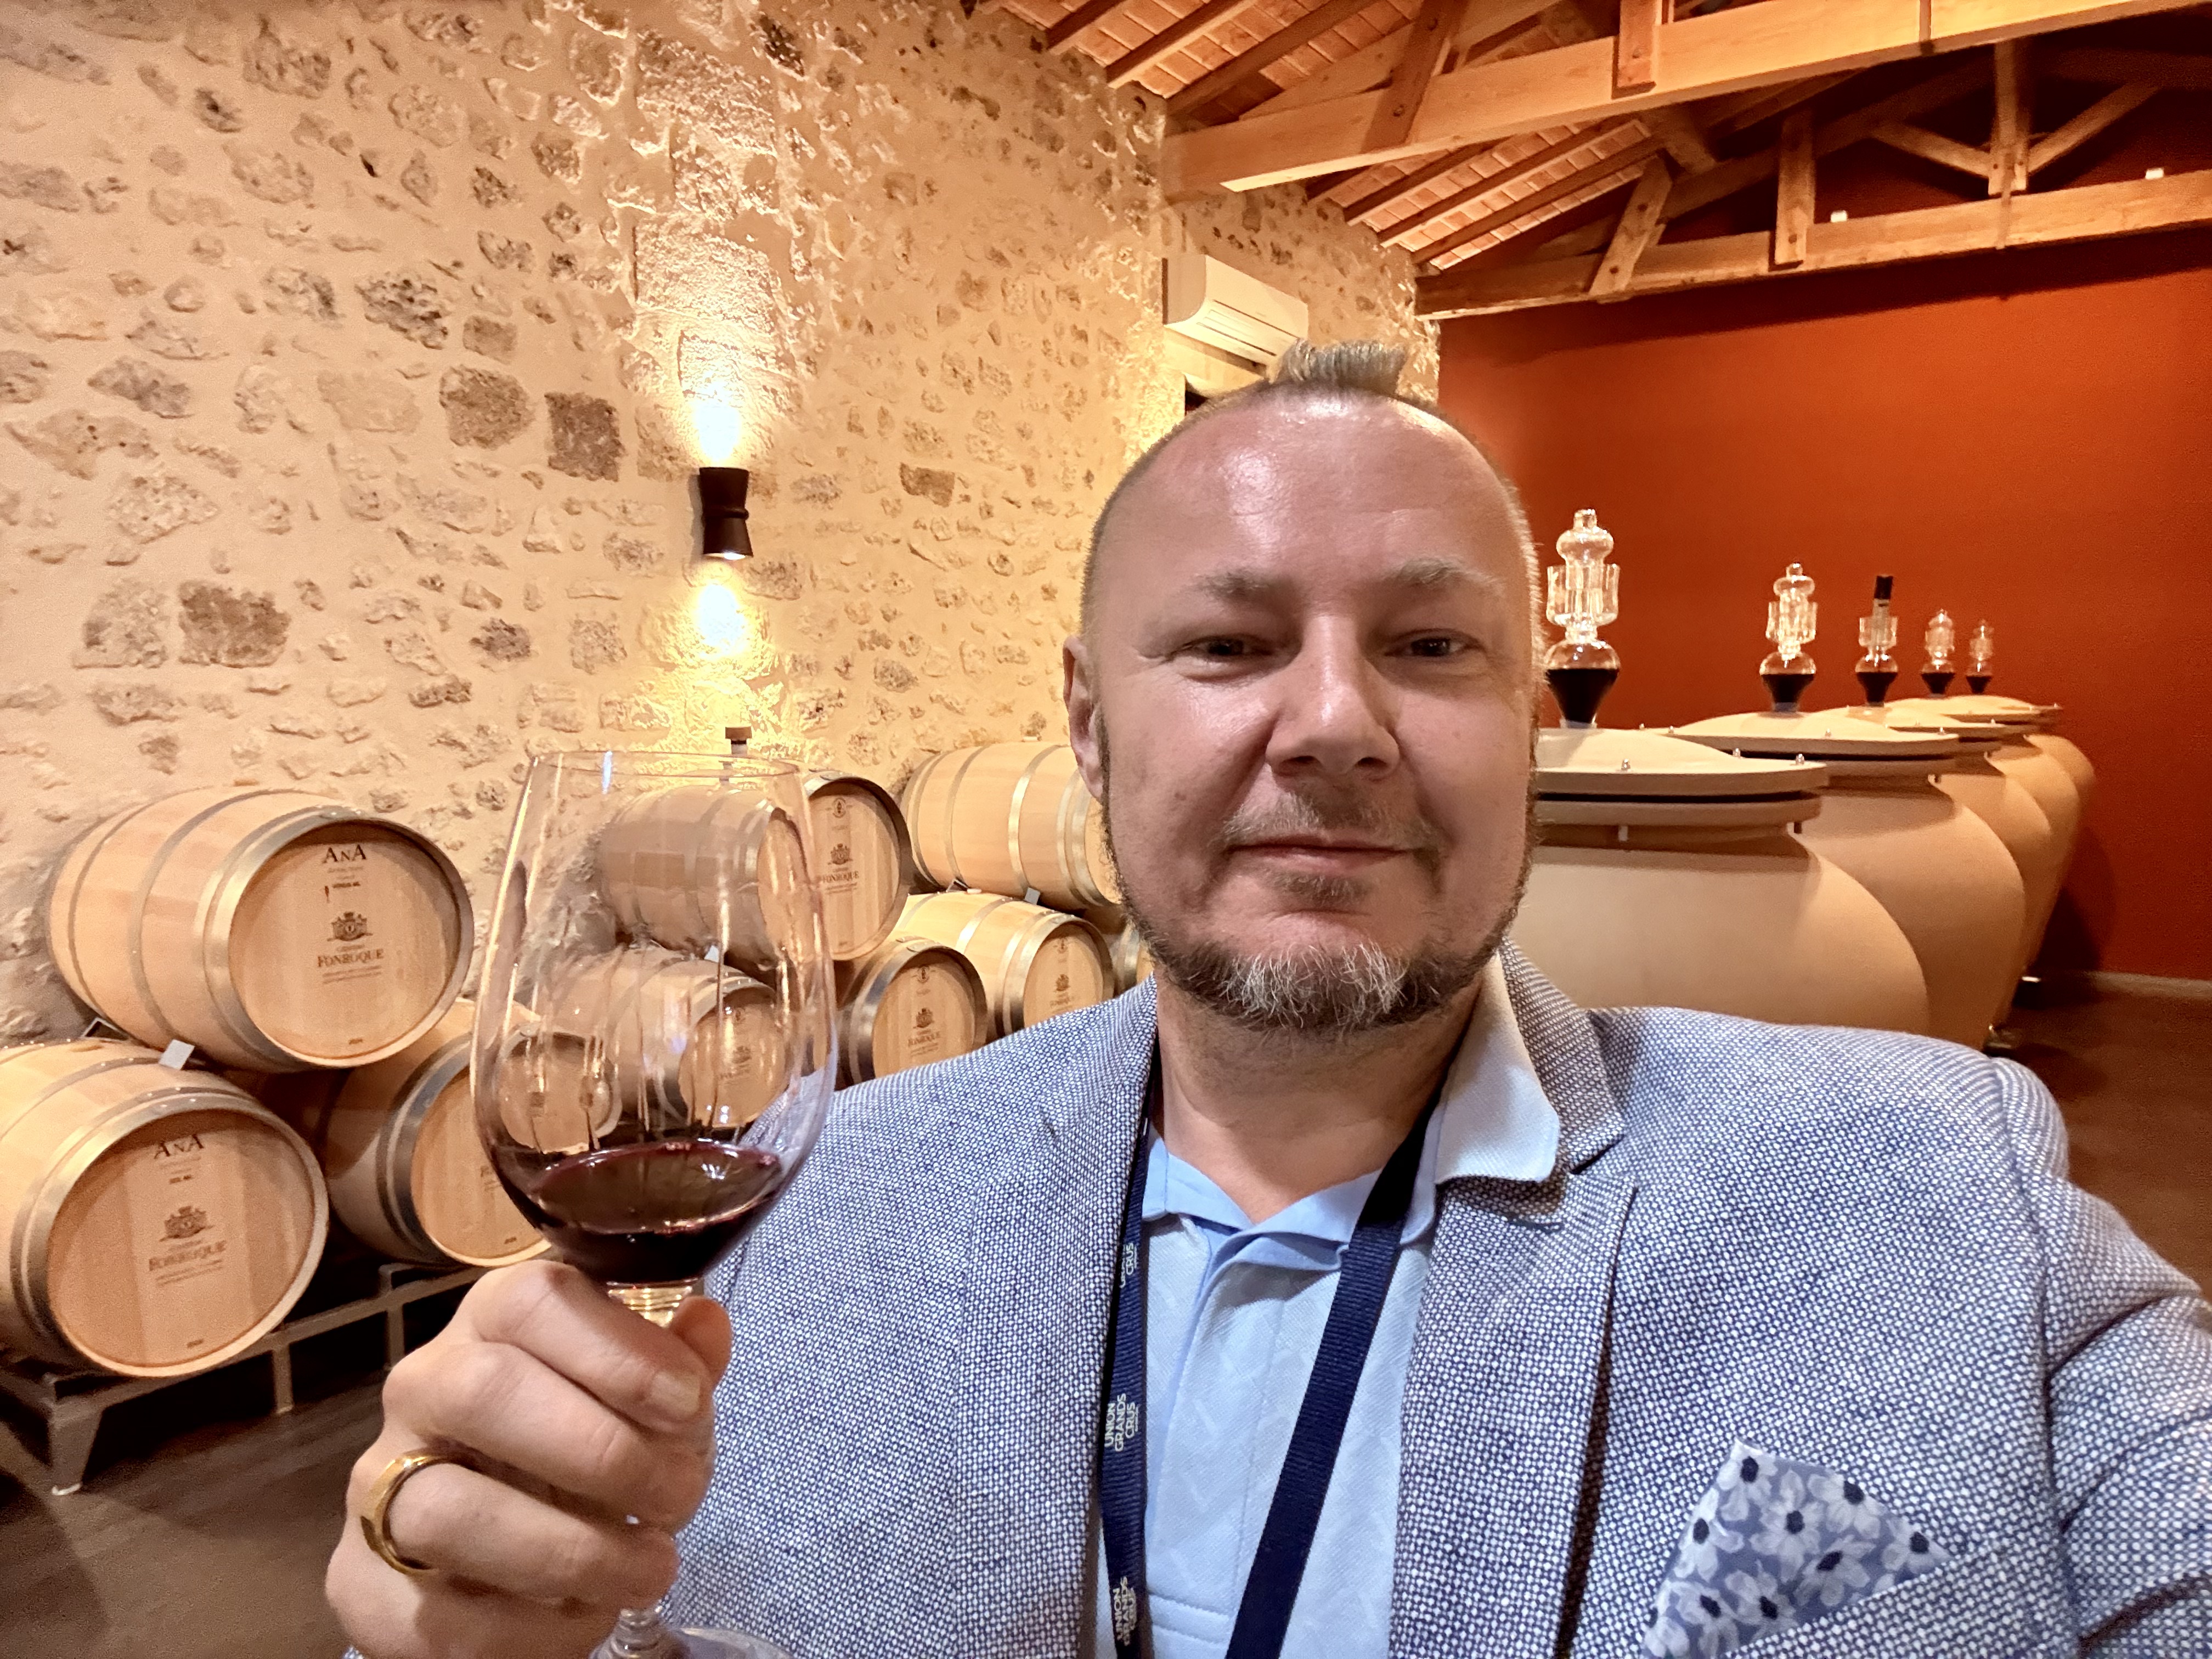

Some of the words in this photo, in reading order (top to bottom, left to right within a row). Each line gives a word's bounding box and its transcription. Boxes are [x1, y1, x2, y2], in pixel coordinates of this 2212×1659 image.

[1126, 1242, 1134, 1276] CRUS
[1104, 1403, 1115, 1447] UNION
[1115, 1393, 1126, 1452] GRANDS
[1125, 1402, 1135, 1438] CRUS
[1113, 1588, 1123, 1641] UNION
[1120, 1576, 1130, 1646] GRANDS
